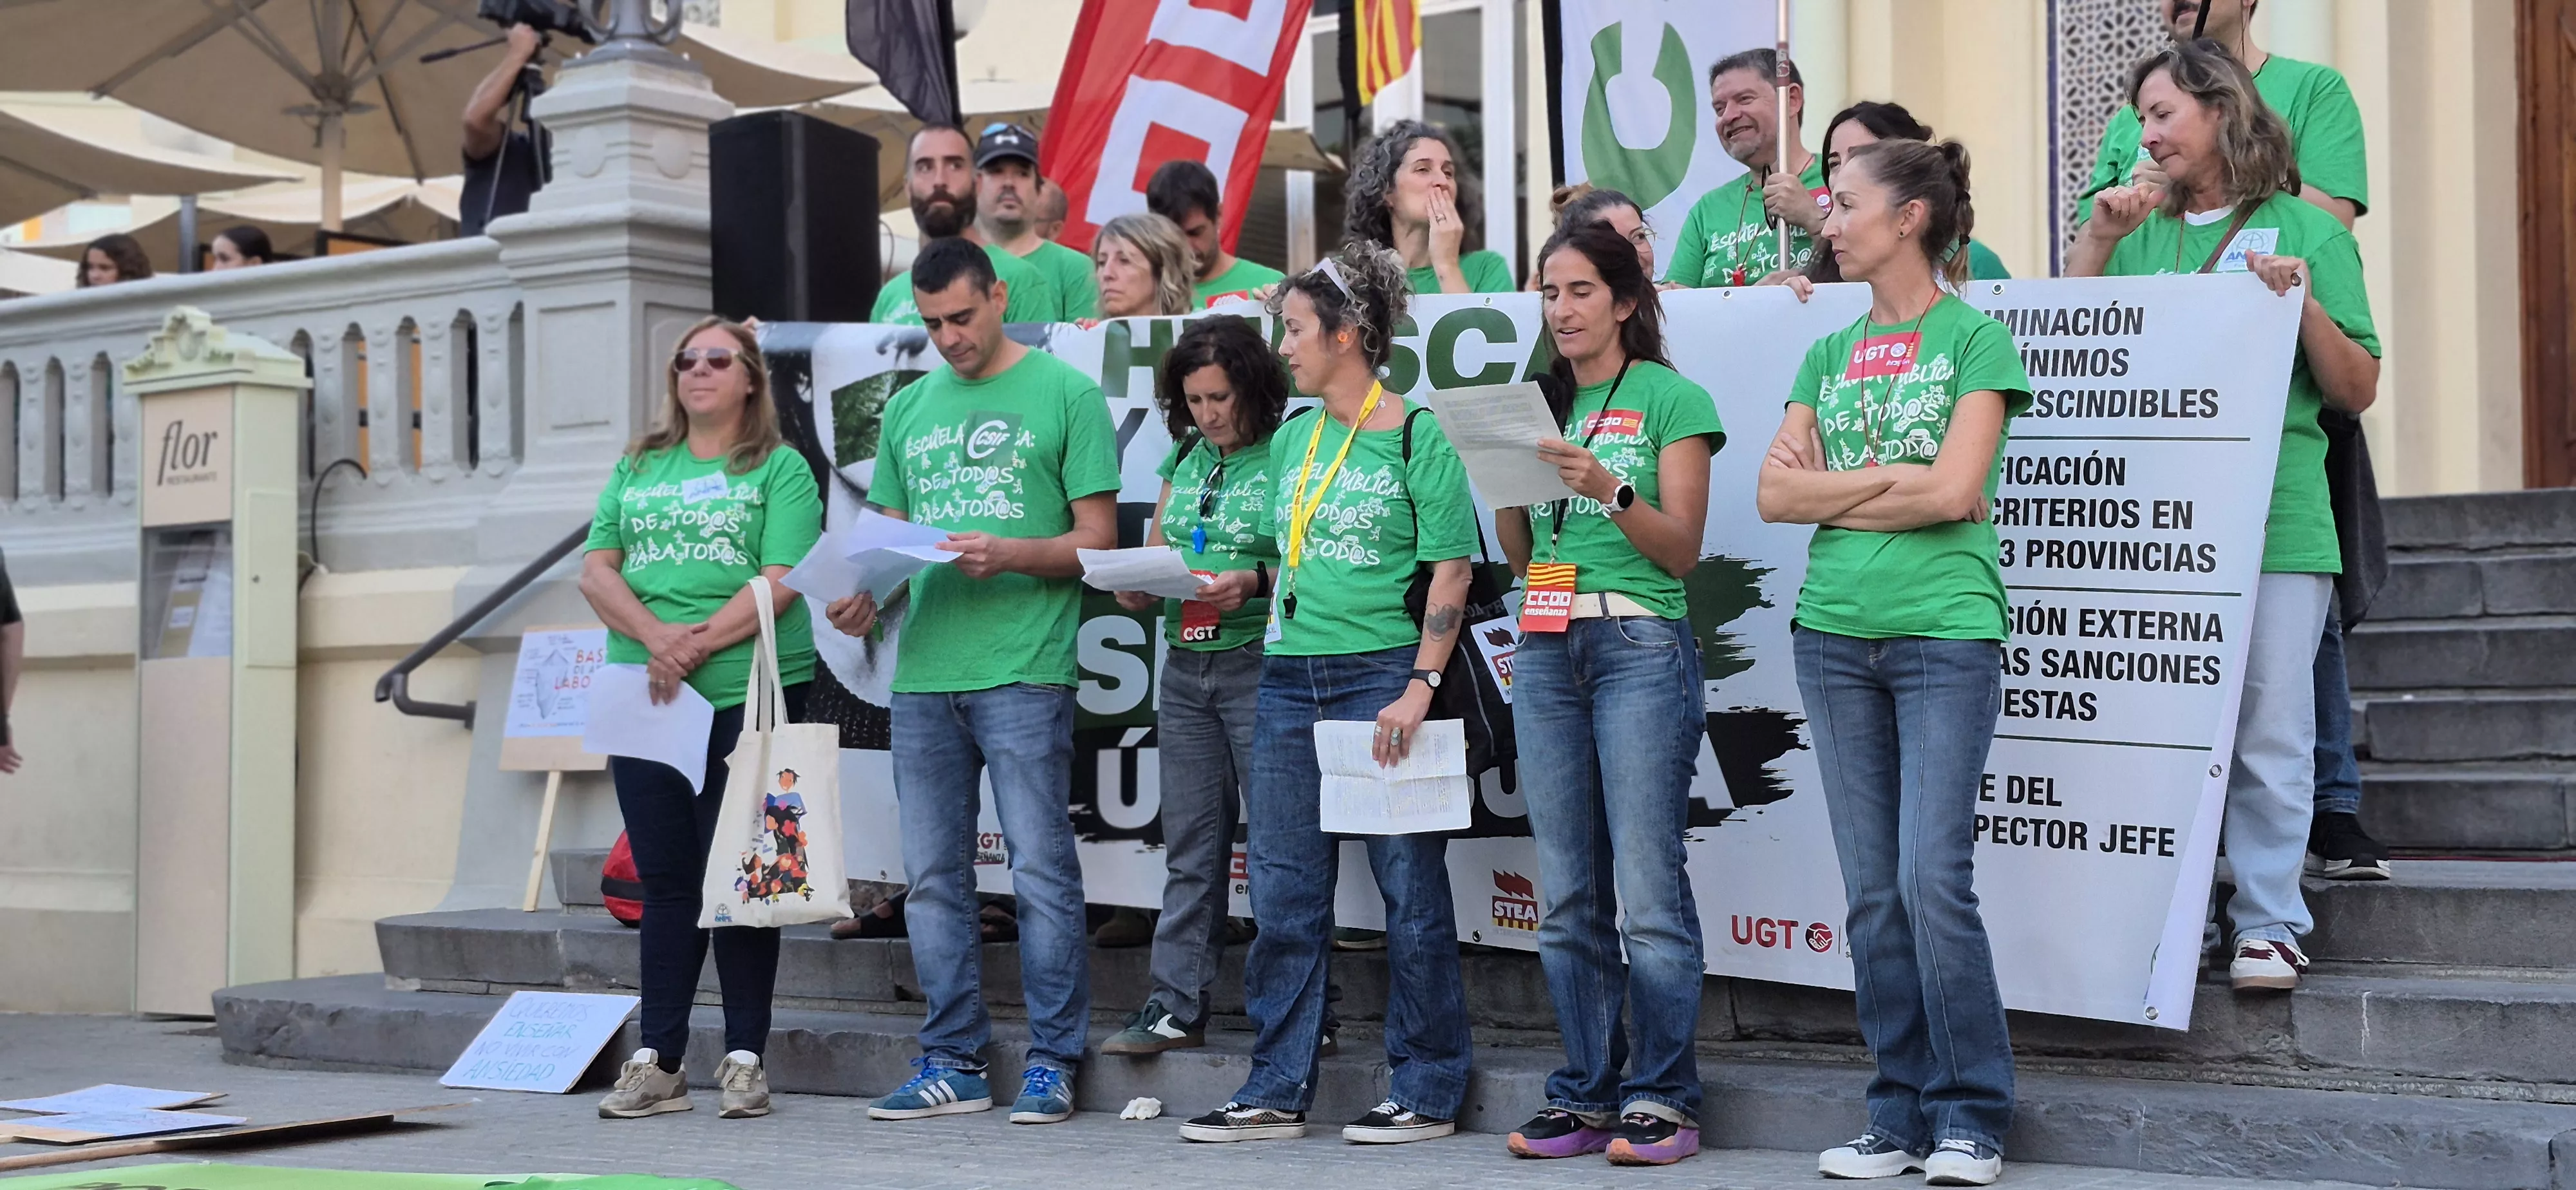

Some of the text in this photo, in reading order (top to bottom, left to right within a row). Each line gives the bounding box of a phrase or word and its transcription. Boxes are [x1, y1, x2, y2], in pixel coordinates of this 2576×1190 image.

[1854, 344, 1889, 364] UGT
[1824, 397, 1940, 437] DE TOD@S
[157, 419, 219, 487] flor
[623, 484, 684, 502] ESCUEL
[919, 466, 1014, 495] DE TOD@S
[631, 509, 740, 533] DE TOD@S
[959, 499, 1025, 520] TOD@S
[1314, 502, 1375, 529] OD@S
[2152, 500, 2193, 530] EN
[680, 542, 748, 565] TOD@S
[2026, 540, 2216, 573] PROVINCIAS
[1524, 606, 1568, 616] enseñanza
[1526, 590, 1573, 607] CCOO
[1183, 625, 1217, 641] CGT
[2079, 608, 2224, 643] EXTERNA
[2040, 648, 2221, 685] SANCIONES
[1998, 688, 2098, 721] ESTAS
[2006, 775, 2063, 808] DEL
[2099, 824, 2175, 858] JEFE
[1494, 900, 1537, 922] STEA
[1731, 914, 1799, 950] UGT
[504, 1021, 577, 1039] ENSEÑAR
[474, 1041, 500, 1055] NO
[463, 1060, 556, 1082] ANSIEDAD
